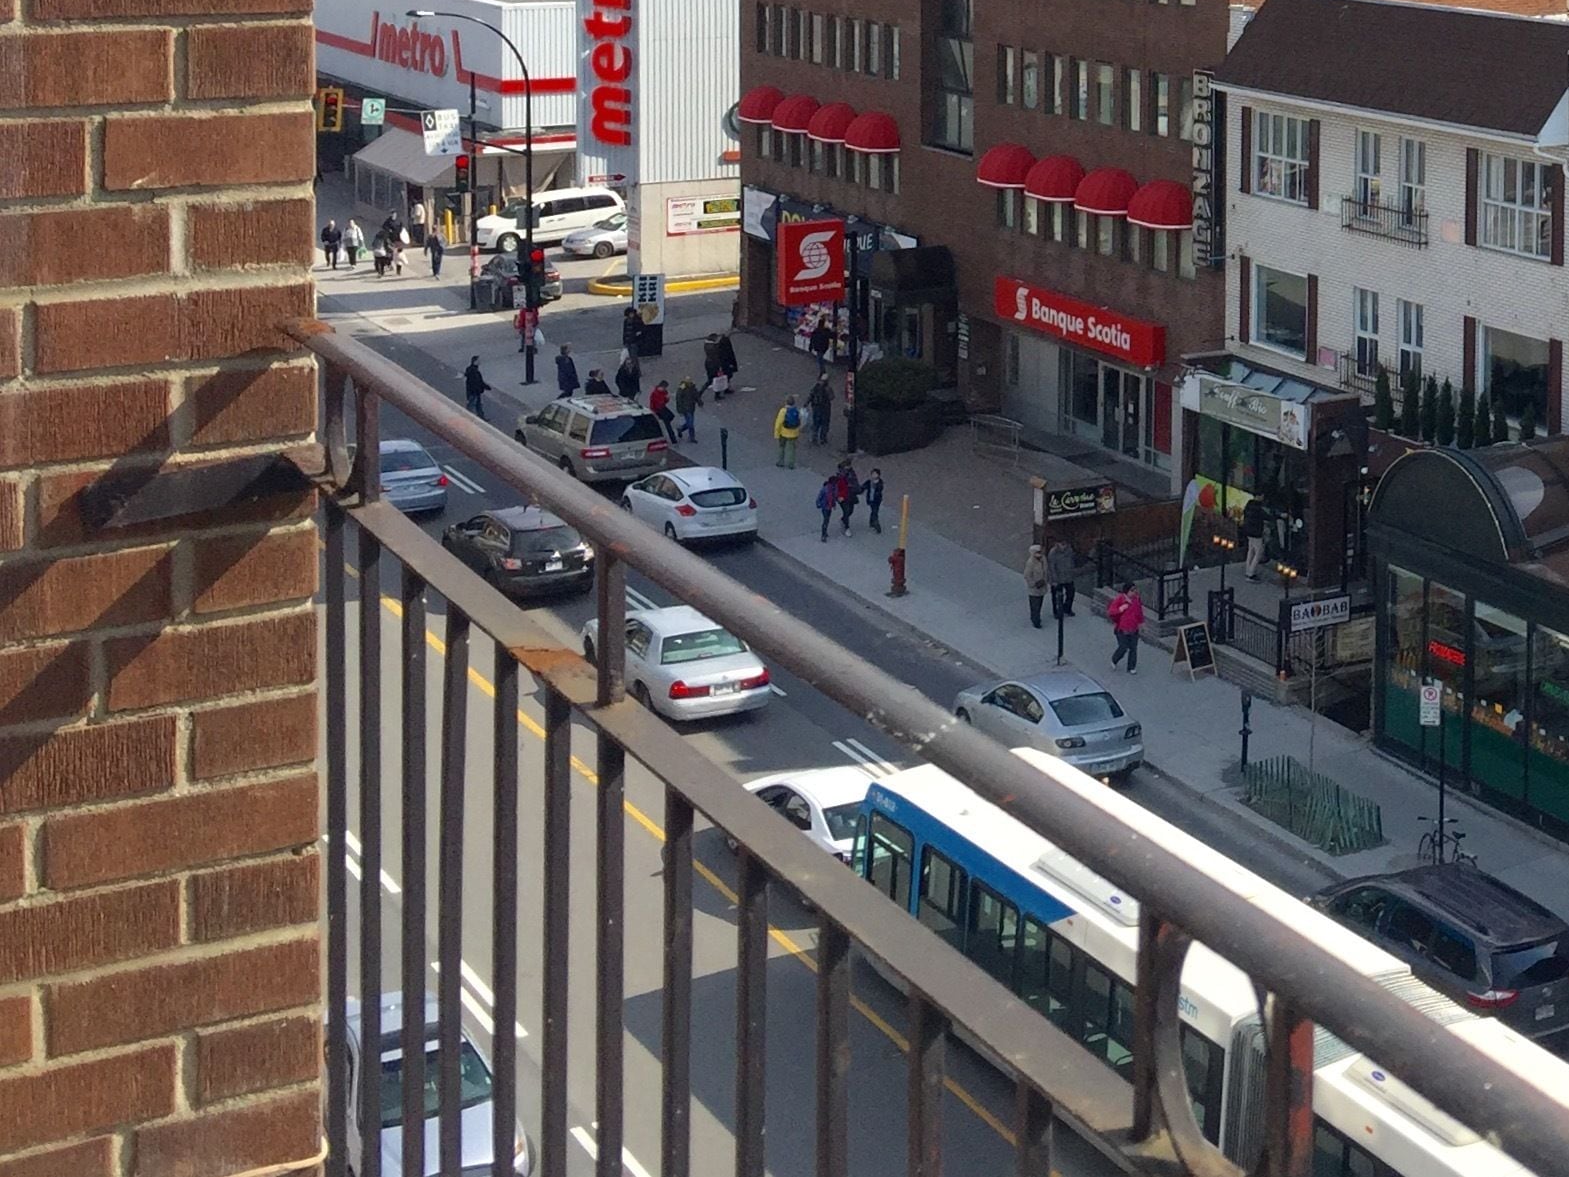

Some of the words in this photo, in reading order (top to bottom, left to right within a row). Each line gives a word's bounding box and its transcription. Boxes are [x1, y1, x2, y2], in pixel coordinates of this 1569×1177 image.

[377, 21, 446, 79] metro
[1031, 297, 1085, 336] Banque
[1087, 316, 1131, 351] Scotia
[1178, 996, 1199, 1020] stm
